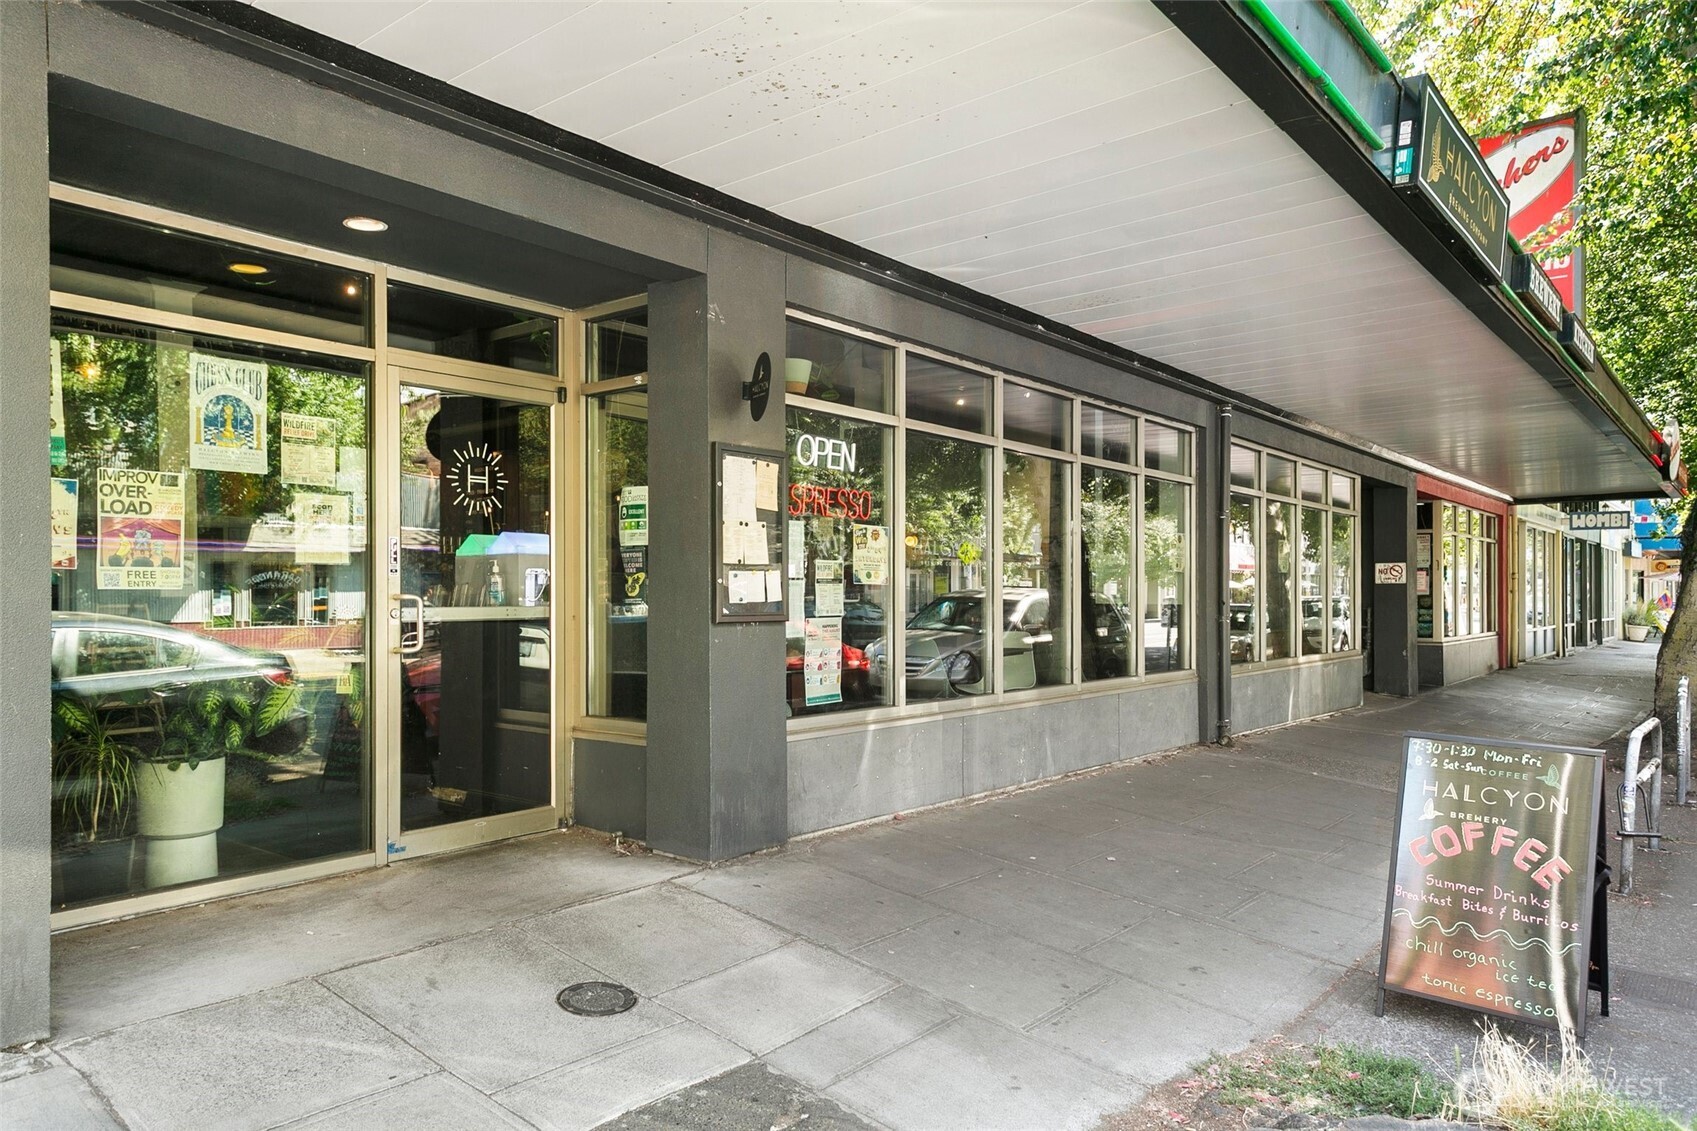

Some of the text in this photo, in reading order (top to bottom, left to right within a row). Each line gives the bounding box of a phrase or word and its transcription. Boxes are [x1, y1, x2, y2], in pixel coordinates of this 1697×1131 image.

[1445, 137, 1498, 232] HALCYON
[1448, 190, 1488, 247] BREWING COMPANY
[1529, 263, 1561, 323] BREWERY
[235, 368, 263, 401] CLUB
[283, 419, 315, 431] WILDFIRE
[797, 434, 857, 473] OPEN
[99, 468, 158, 484] IMPROV
[99, 483, 153, 499] OVER-
[467, 464, 489, 494] H
[100, 498, 153, 515] LOAD
[788, 483, 872, 520] SPRESSO
[1572, 512, 1629, 528] WOMBI
[127, 570, 157, 579] FREE
[127, 580, 157, 588] ENTRY
[1481, 768, 1529, 780] COFFEE
[1422, 780, 1569, 814] HALCYON
[1450, 811, 1508, 826] BREWERY
[1408, 821, 1573, 890] COFFEE
[1395, 884, 1452, 907] Breakfast
[1462, 898, 1494, 915] Bites
[1512, 909, 1579, 932] Burrios
[1425, 874, 1550, 909] Summer Drinks
[1405, 936, 1517, 970] chill organic
[1496, 969, 1520, 984] ice
[1421, 973, 1558, 1018] tonic espresso
